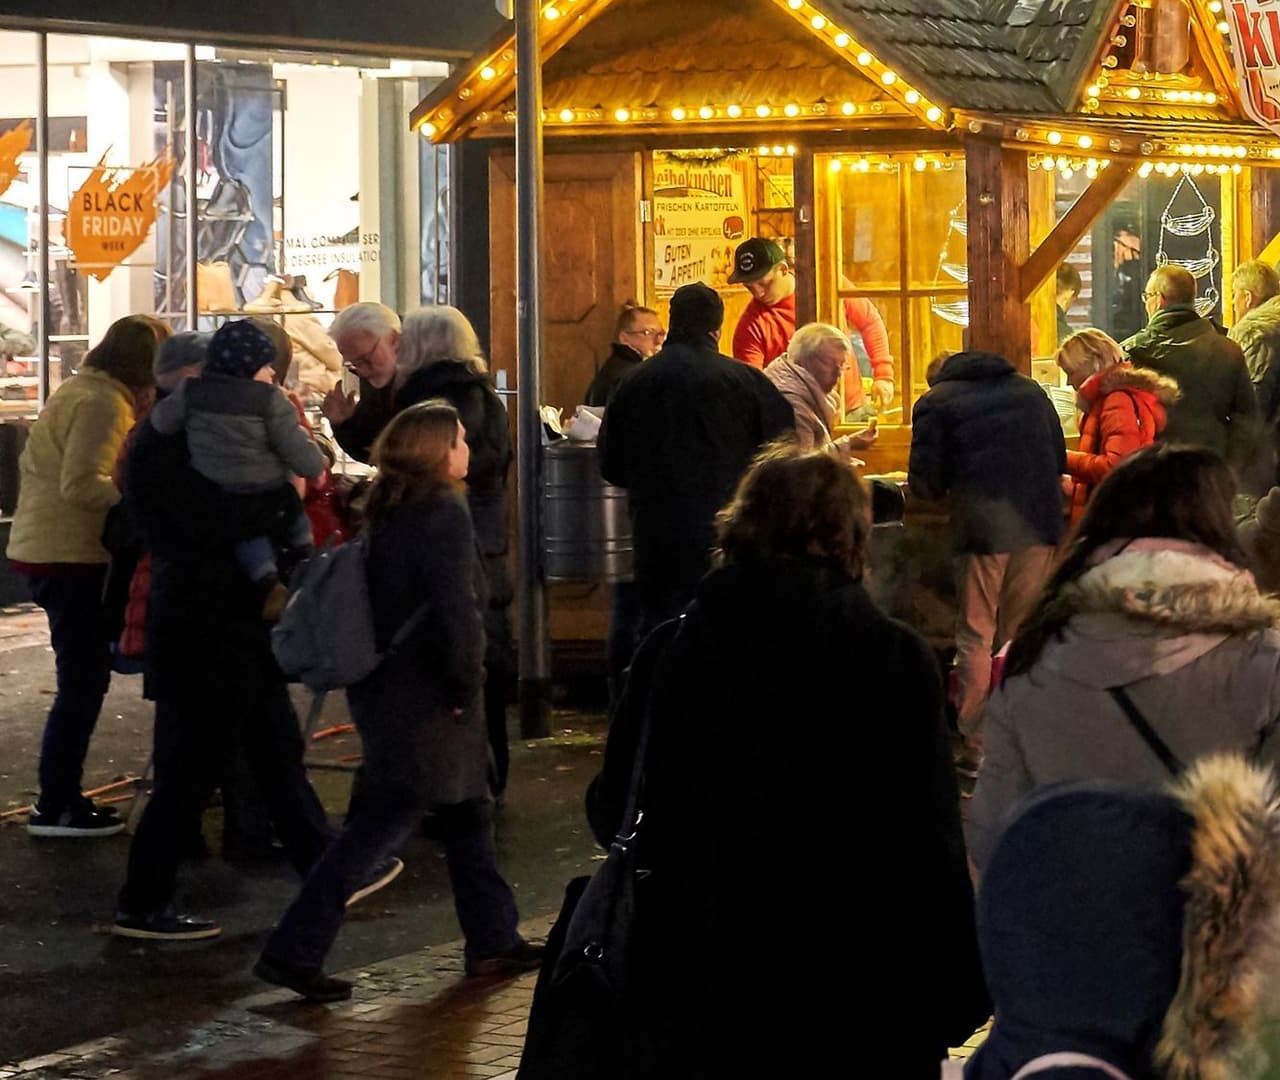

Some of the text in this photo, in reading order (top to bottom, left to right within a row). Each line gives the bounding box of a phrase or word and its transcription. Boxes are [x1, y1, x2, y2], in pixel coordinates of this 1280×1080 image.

[83, 192, 144, 212] BLACK
[656, 201, 739, 212] FRISCHEN KARTOFFELN
[82, 215, 144, 237] FRIDAY
[331, 250, 378, 264] INSULATIO
[664, 243, 692, 264] GUTEN
